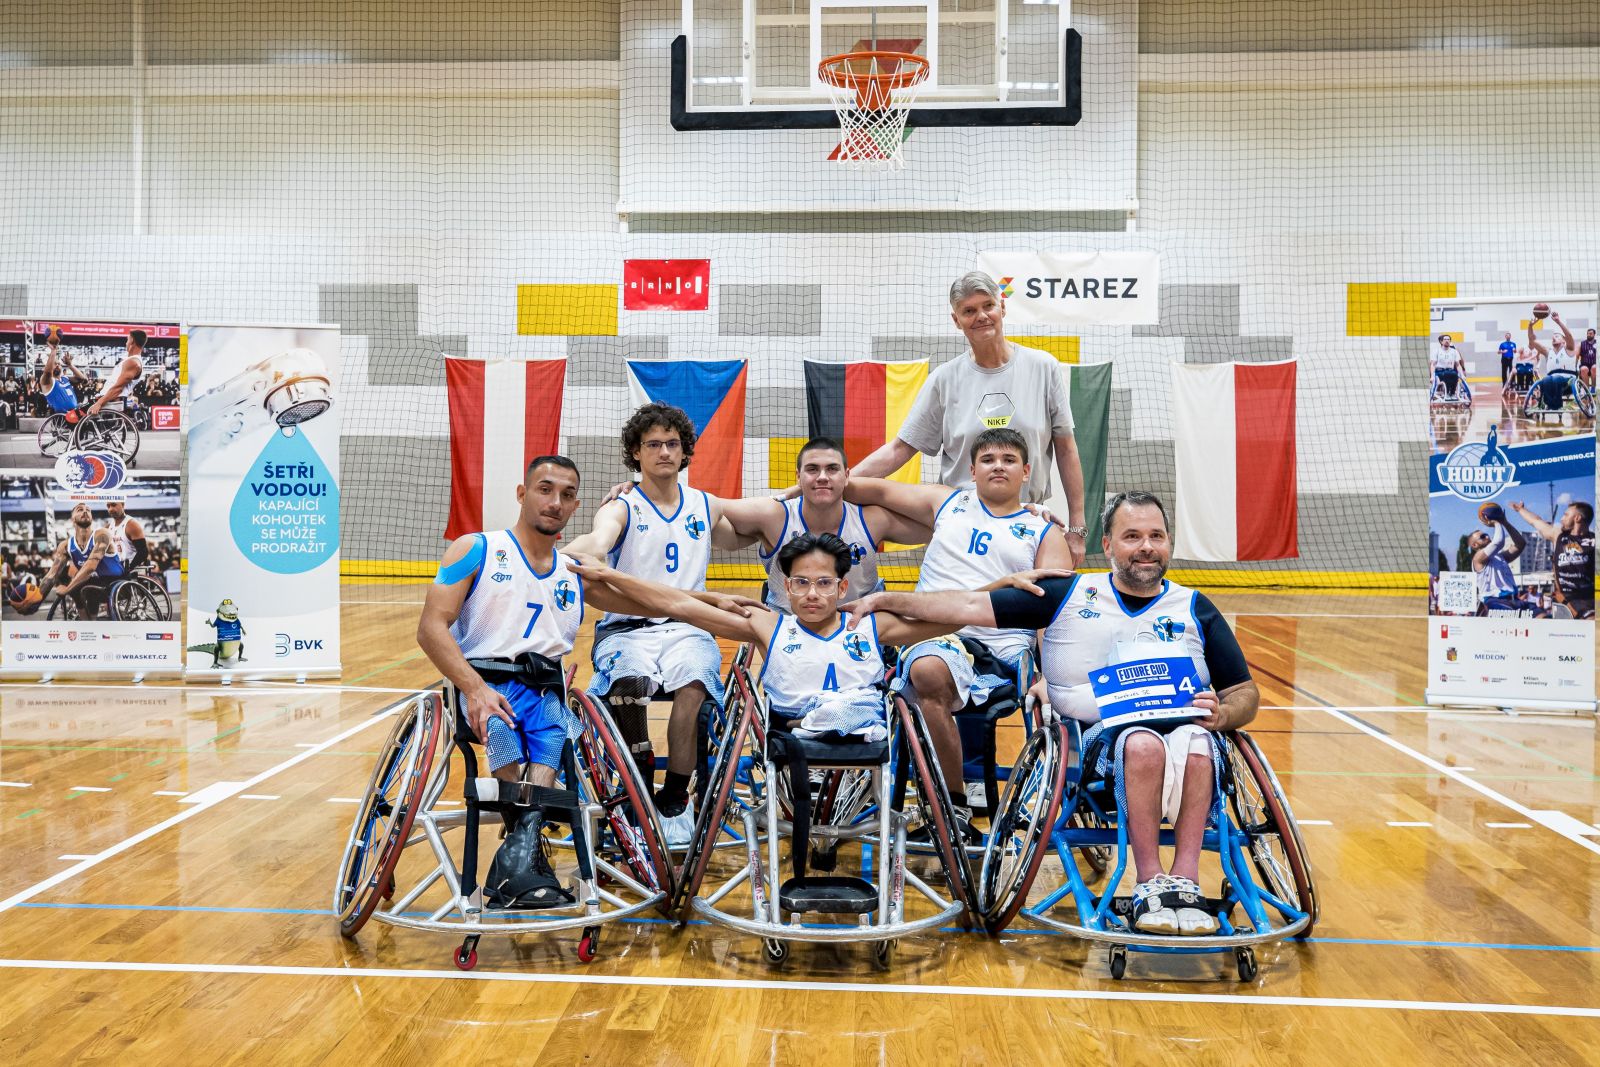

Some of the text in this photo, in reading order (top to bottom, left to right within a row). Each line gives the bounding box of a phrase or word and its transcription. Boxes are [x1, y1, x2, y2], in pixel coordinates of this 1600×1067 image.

[1025, 277, 1138, 299] STAREZ
[1518, 451, 1596, 468] WWW.HOBITBRNO.CZ
[264, 461, 314, 478] ŠETŘI
[1447, 466, 1506, 482] HOBIT
[250, 482, 326, 496] VODOU!
[1463, 485, 1492, 494] BRNO
[259, 498, 320, 511] KAPAJÍCÍ
[252, 514, 327, 525] KOHOUTEK
[260, 526, 317, 540] SE MŮŽE
[251, 540, 327, 554] PRODRAŽIT
[968, 528, 992, 556] 16
[666, 542, 679, 574] 9
[522, 602, 544, 639] 7
[294, 639, 323, 650] BVK
[822, 662, 840, 692] 4
[1118, 664, 1168, 680] FUTURE CUP
[1178, 676, 1196, 694] 4
